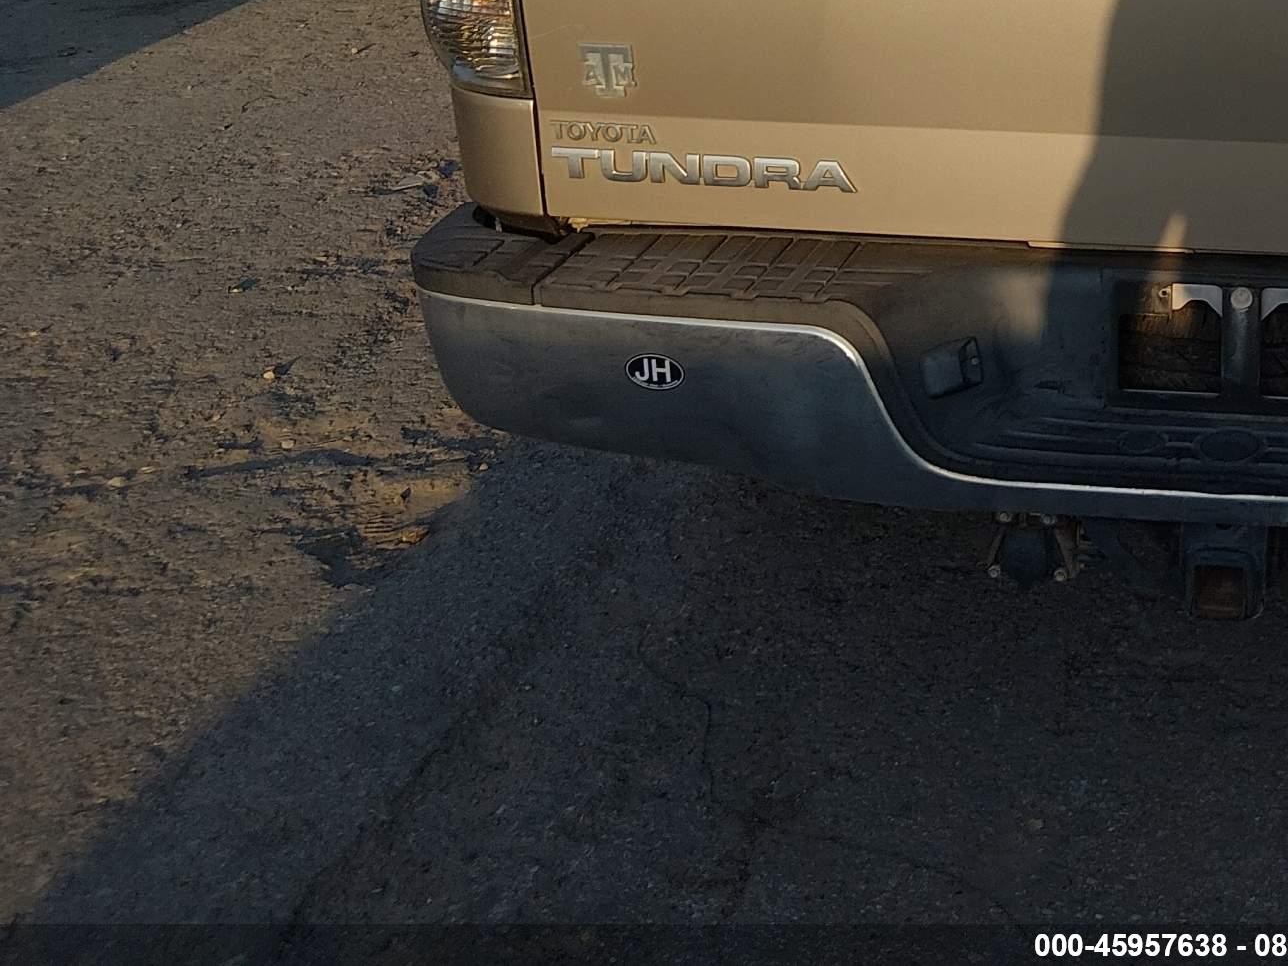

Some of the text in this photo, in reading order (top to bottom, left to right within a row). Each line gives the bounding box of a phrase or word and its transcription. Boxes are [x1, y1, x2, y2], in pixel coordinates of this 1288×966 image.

[551, 120, 657, 144] TOYOTA
[551, 146, 858, 193] TUNDRA
[634, 358, 672, 383] JH
